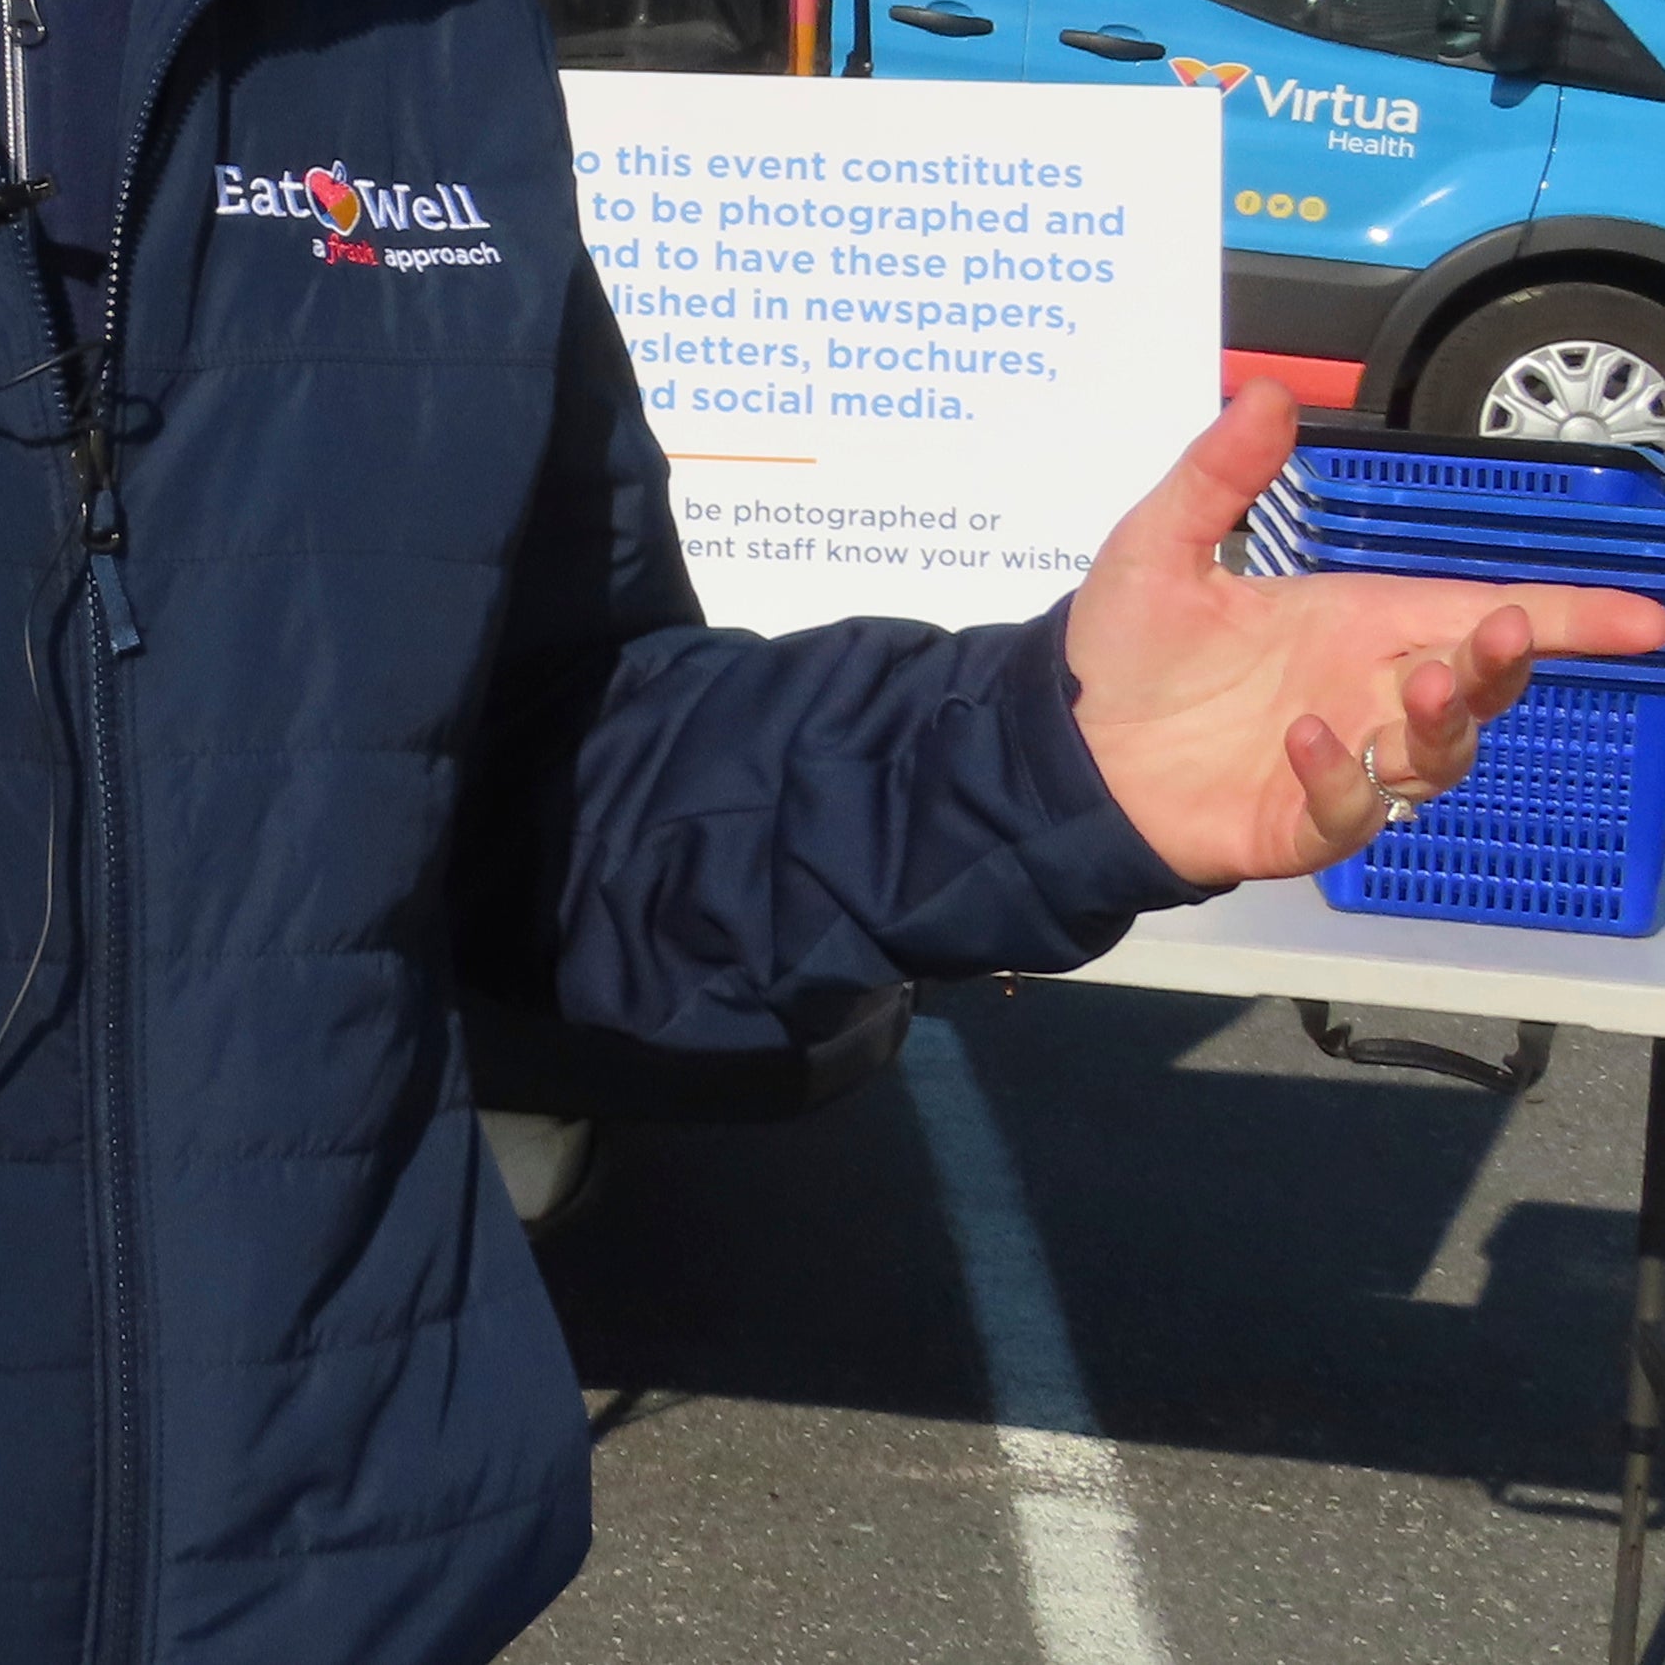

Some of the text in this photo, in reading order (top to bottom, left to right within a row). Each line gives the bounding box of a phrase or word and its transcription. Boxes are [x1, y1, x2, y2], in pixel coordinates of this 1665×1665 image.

[1254, 75, 1419, 134] Virtua
[1327, 130, 1415, 158] Health
[572, 145, 1083, 188] o this event constitutes
[214, 164, 491, 231] Eat Well
[592, 192, 1125, 237] to be photographed and
[311, 237, 327, 259] a
[384, 241, 502, 272] approach
[589, 238, 1115, 285] nd to have these photos
[611, 283, 1077, 335] lished in newspapers,
[828, 337, 1057, 382] brochures,
[692, 382, 813, 415] social
[830, 387, 974, 420] media.
[684, 497, 1002, 533] be photographed or
[746, 538, 816, 561] staff
[826, 539, 909, 566] know
[920, 545, 990, 570] your
[1002, 546, 1093, 572] wishe
